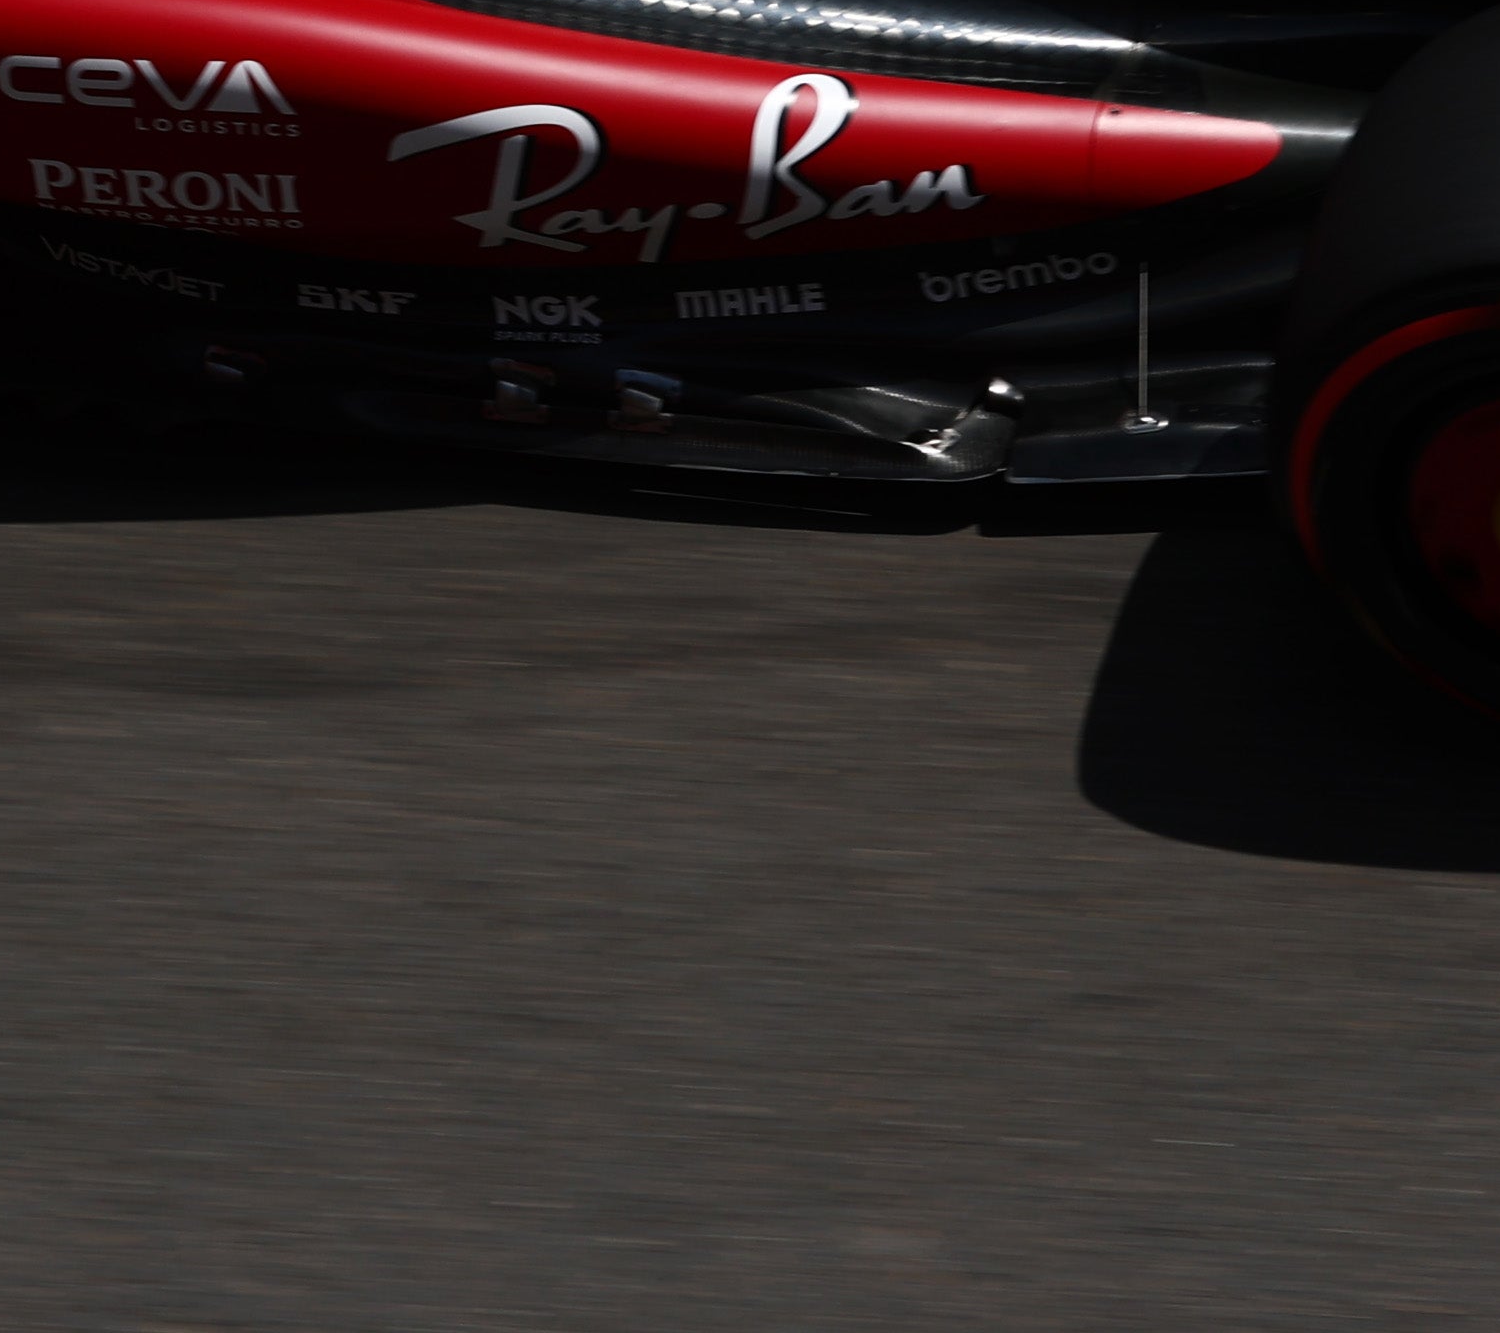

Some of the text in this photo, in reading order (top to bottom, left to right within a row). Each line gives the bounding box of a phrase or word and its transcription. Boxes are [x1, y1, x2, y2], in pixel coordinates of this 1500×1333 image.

[135, 117, 301, 139] LOGISTICS
[26, 158, 302, 214] PERONI
[916, 249, 1120, 305] brembo
[297, 282, 419, 316] SKF
[493, 294, 603, 327] NGK
[673, 281, 829, 320] MAHLE
